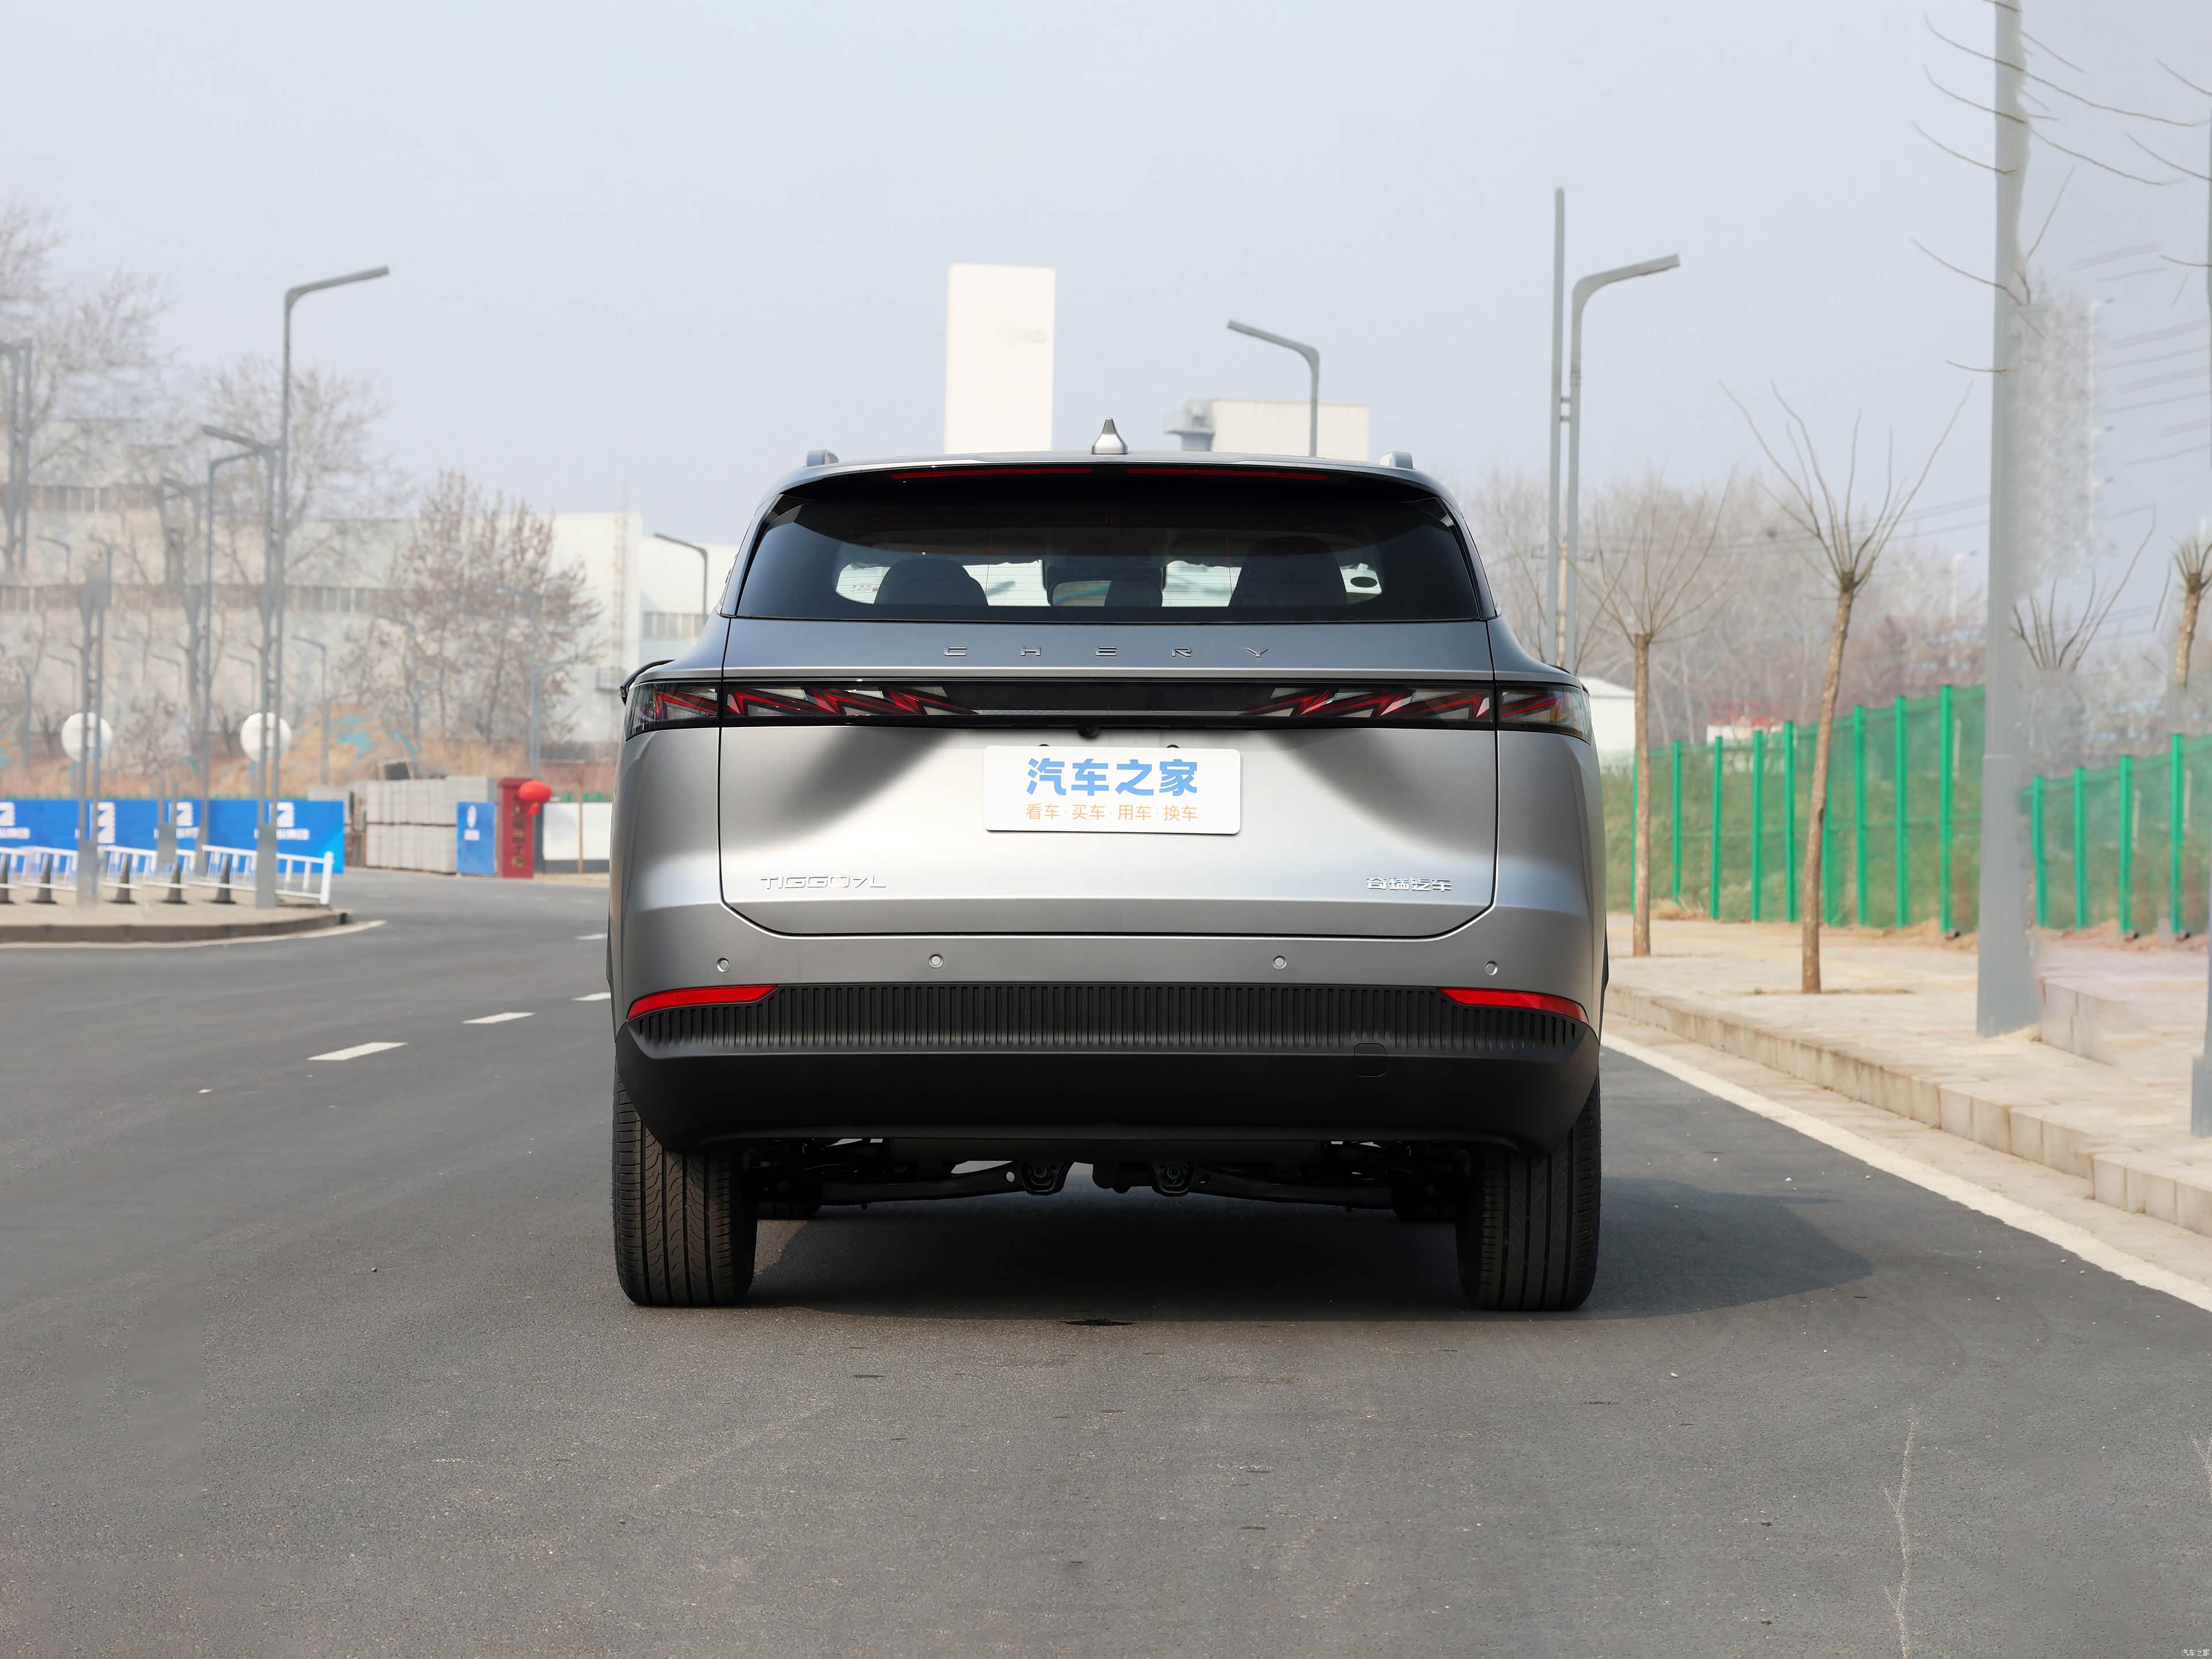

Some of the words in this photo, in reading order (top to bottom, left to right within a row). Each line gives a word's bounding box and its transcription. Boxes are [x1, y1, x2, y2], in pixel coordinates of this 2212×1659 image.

[944, 646, 1268, 658] CHERY
[1026, 758, 1198, 796] 汽车之家
[1366, 876, 1452, 892] 奇瑞汽车
